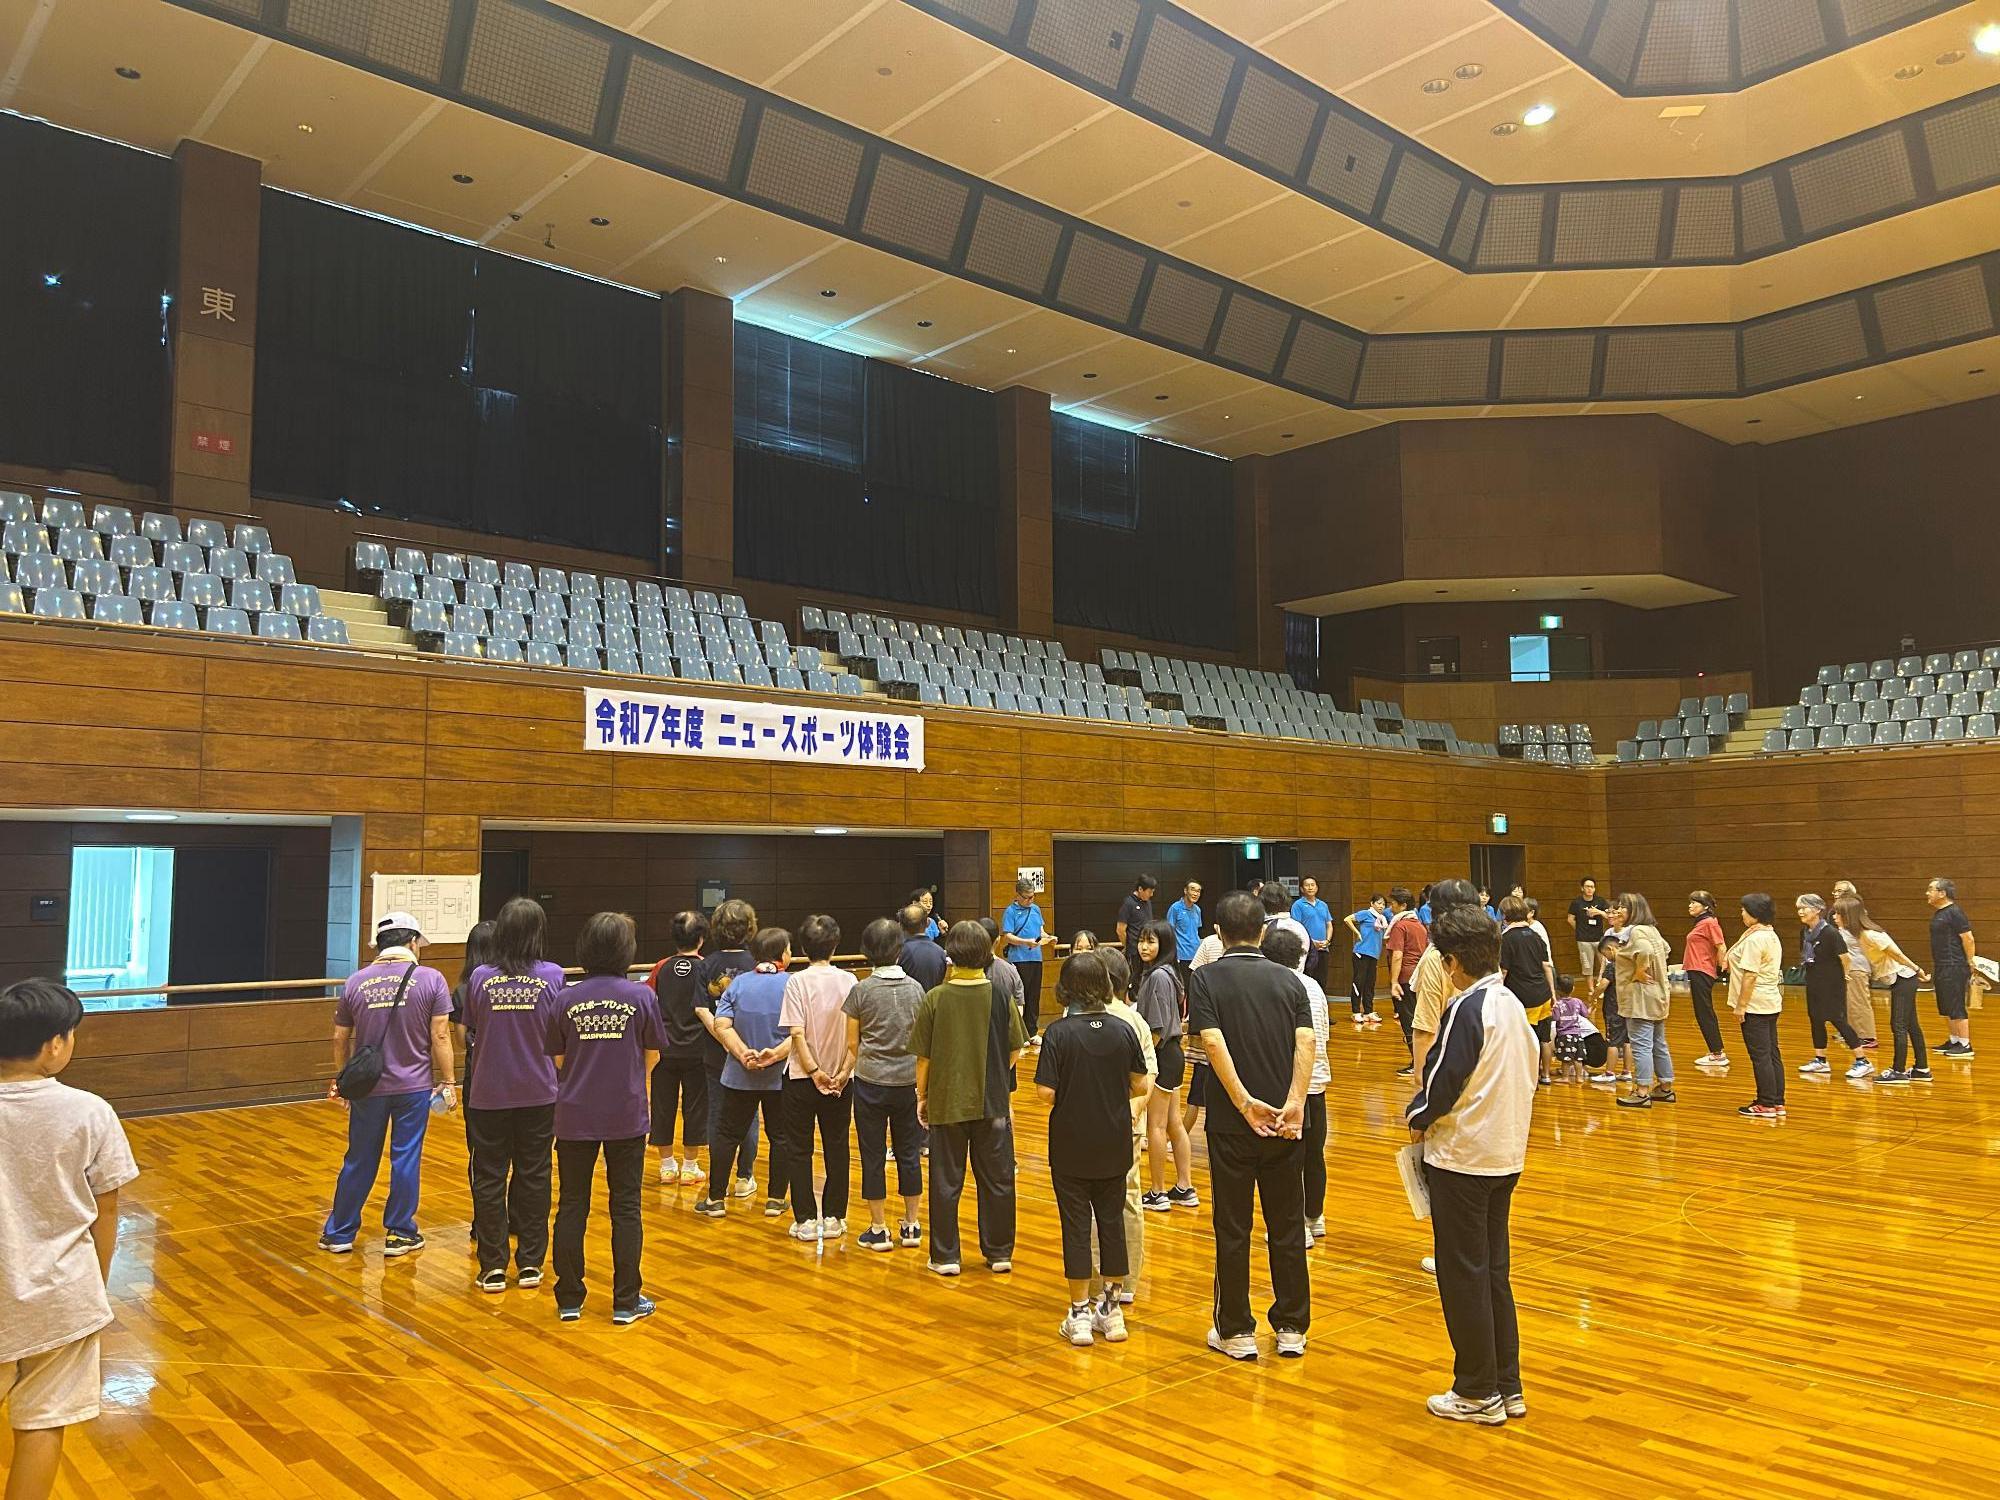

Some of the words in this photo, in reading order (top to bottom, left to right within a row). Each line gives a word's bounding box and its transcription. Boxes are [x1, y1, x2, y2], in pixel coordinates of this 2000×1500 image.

[200, 287, 236, 322] 東
[197, 436, 232, 451] 禁煙
[595, 698, 705, 750] 令和7年度
[718, 713, 910, 762] ニュースポーツ体験会
